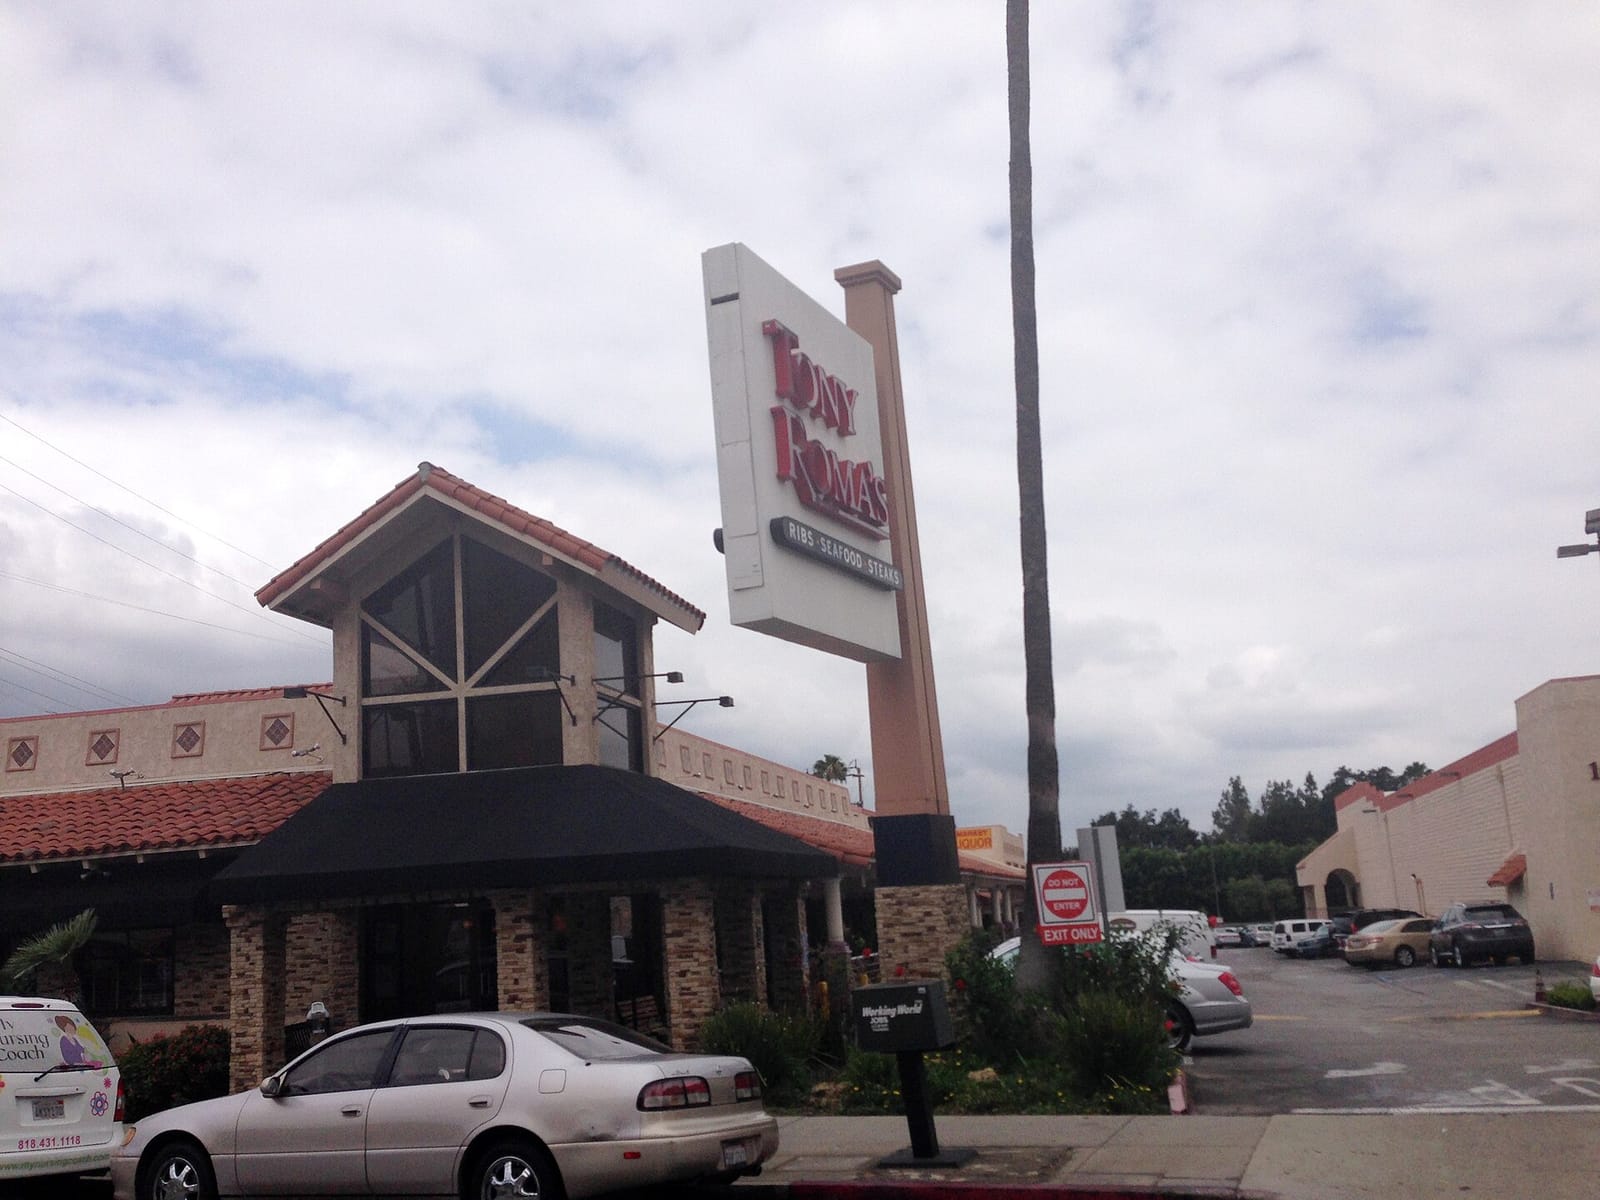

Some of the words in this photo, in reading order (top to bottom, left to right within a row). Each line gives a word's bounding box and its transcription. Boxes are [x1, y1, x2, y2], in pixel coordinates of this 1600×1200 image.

[762, 319, 859, 437] TONY
[789, 522, 815, 547] RIBS
[820, 537, 863, 569] SEAFOOD
[868, 559, 900, 585] STEAKS
[957, 837, 992, 849] IQUOR
[1048, 879, 1060, 887] DO
[1062, 878, 1078, 887] NOT
[1053, 902, 1080, 911] ENTER
[1044, 929, 1068, 941] EXIT
[1071, 927, 1098, 939] ONLY
[862, 1005, 897, 1018] Working
[897, 1002, 922, 1014] World
[0, 1034, 49, 1048] ursing
[18, 1136, 81, 1149] 818.431.1118
